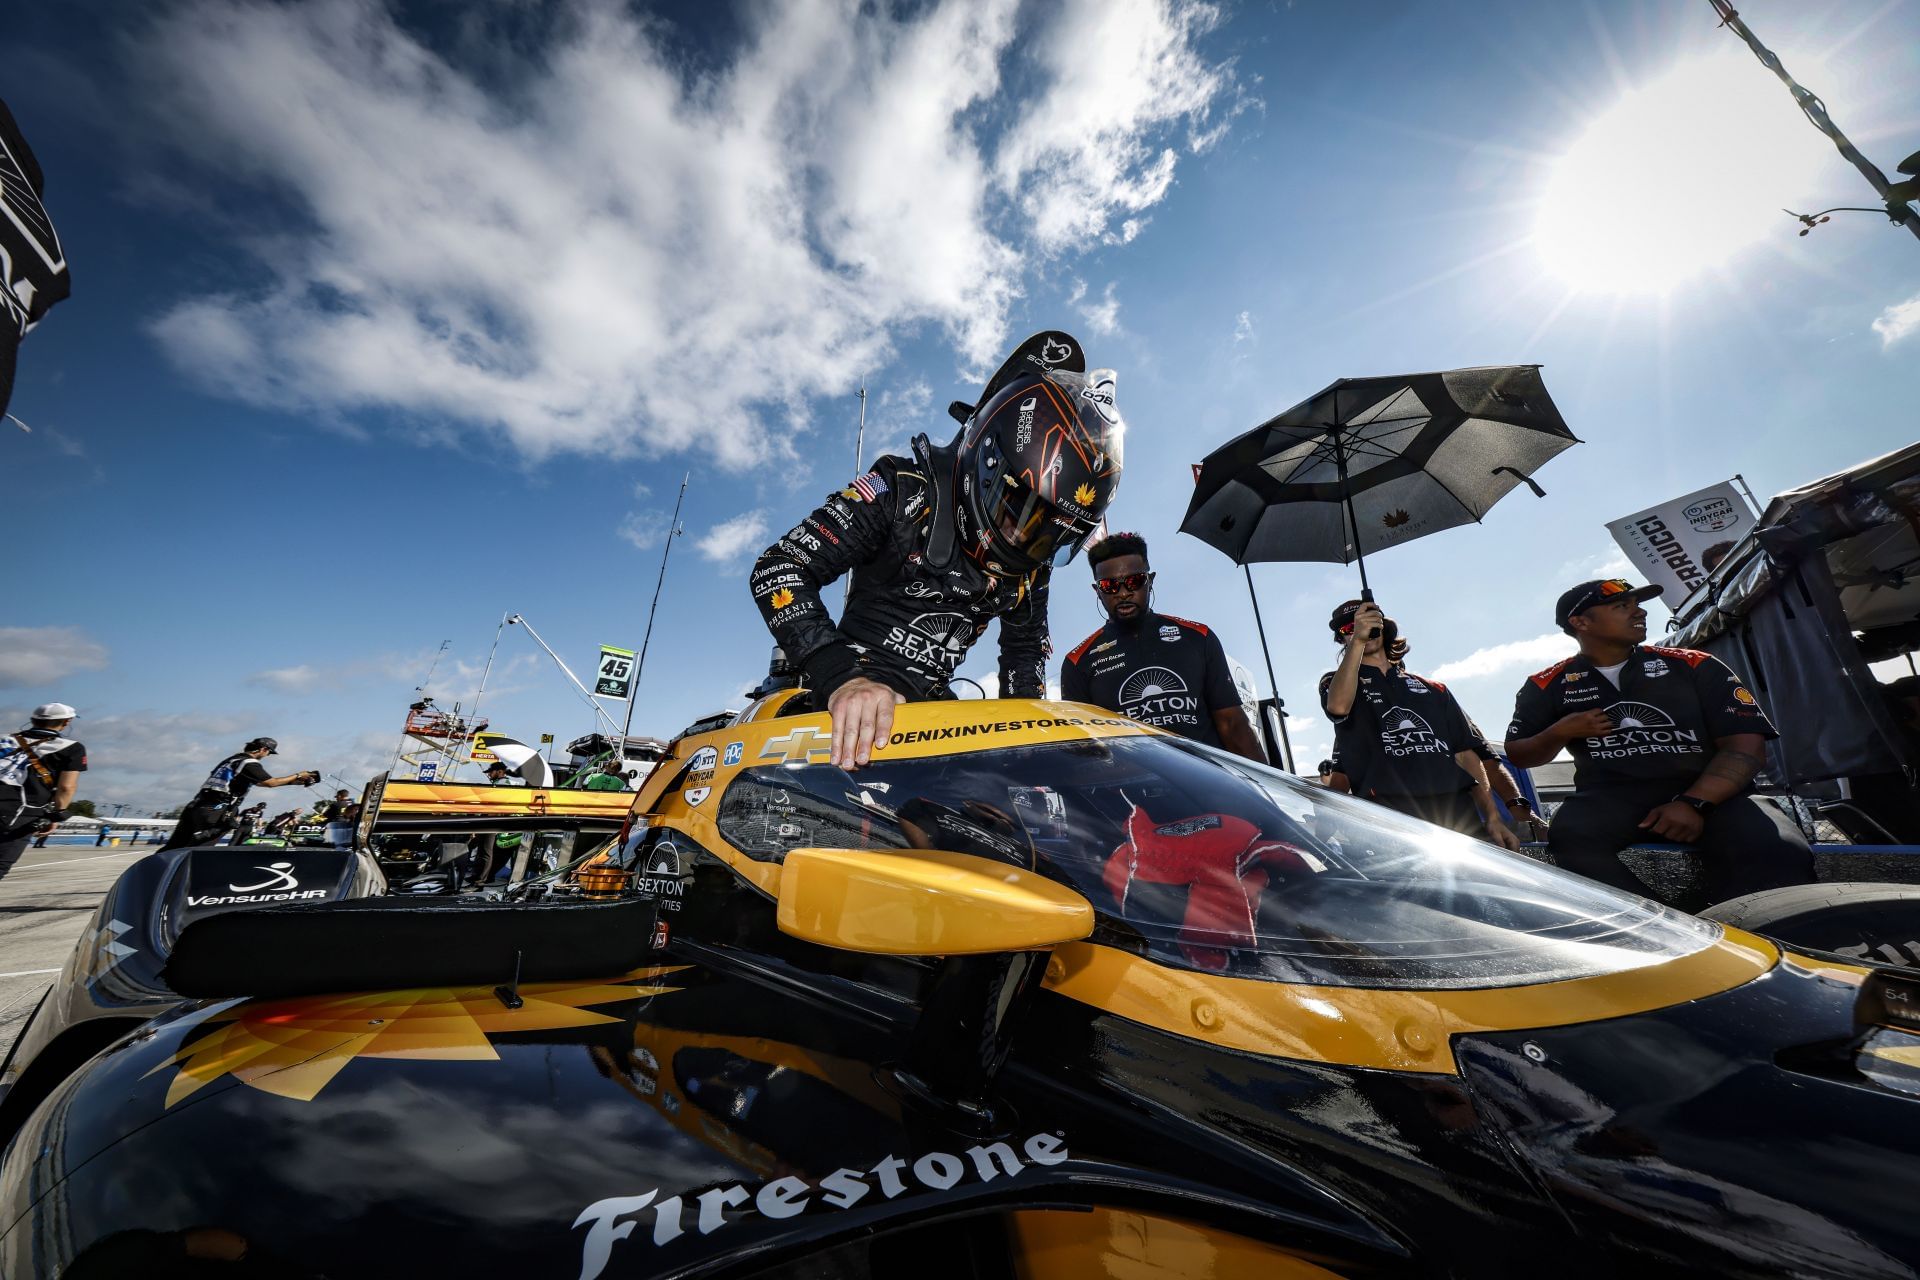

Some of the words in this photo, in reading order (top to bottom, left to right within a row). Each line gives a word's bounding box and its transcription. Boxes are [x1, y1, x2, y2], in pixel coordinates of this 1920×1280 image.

[1016, 411, 1027, 453] PRODUCTS
[1024, 411, 1034, 444] GENESIS
[1704, 500, 1726, 511] NTT
[1689, 507, 1734, 525] INDYCAR
[800, 533, 821, 551] IFS
[1624, 525, 1660, 565] SANTINO
[755, 573, 802, 594] CLY-DEL
[768, 601, 815, 628] PHOENIX
[1108, 652, 1126, 661] RACING
[601, 659, 630, 678] 45
[1118, 697, 1198, 721] EXTON
[1586, 729, 1698, 748] SEXTON
[701, 755, 716, 766] NTT
[1591, 744, 1704, 760] PROPERTIES
[420, 769, 436, 778] 66
[686, 770, 715, 782] INDYCAR
[637, 876, 684, 897] SEXTON
[187, 889, 327, 906] VensureHR
[571, 1132, 1069, 1280] Firestone
